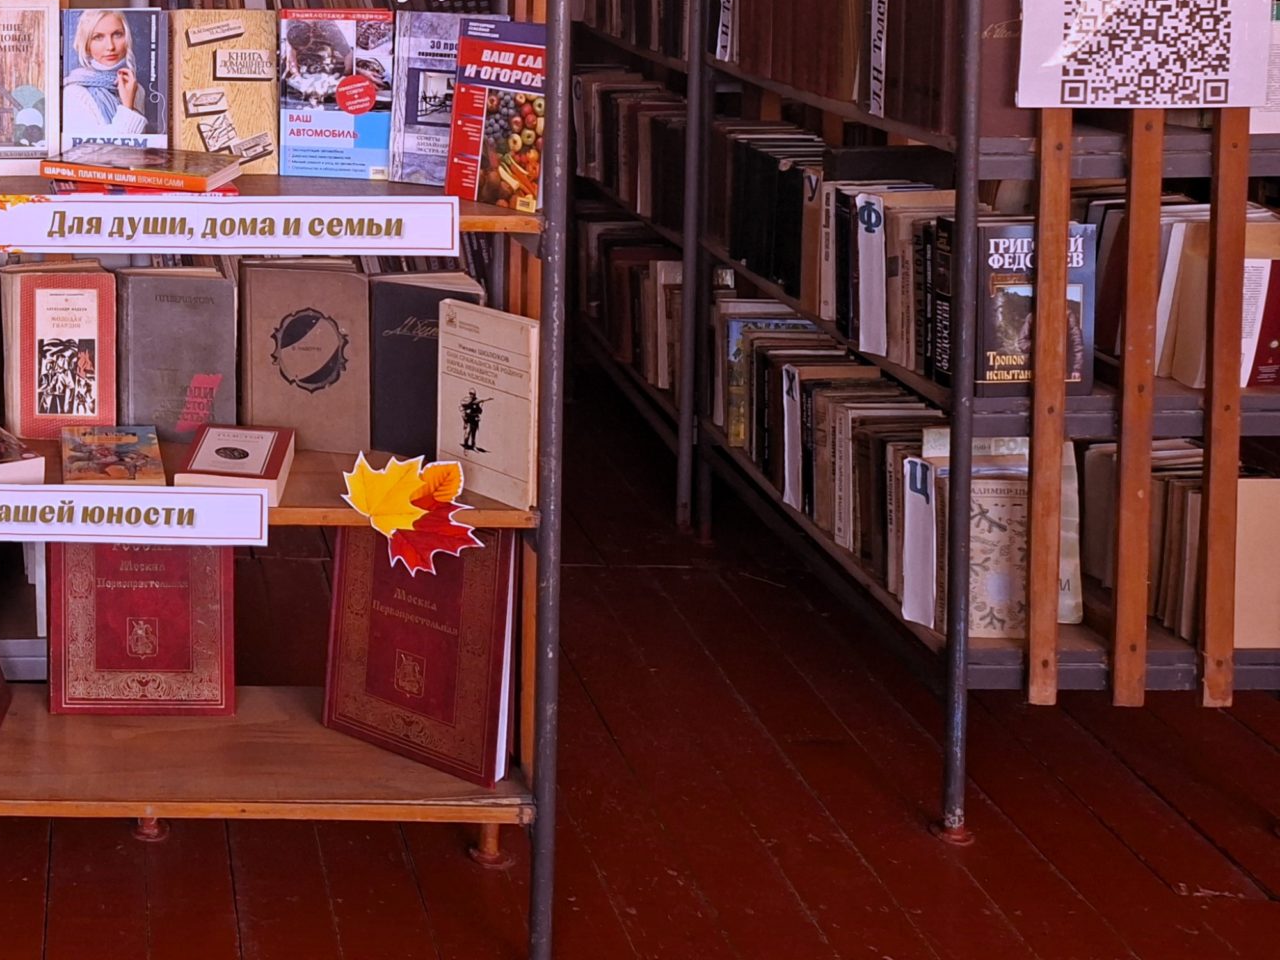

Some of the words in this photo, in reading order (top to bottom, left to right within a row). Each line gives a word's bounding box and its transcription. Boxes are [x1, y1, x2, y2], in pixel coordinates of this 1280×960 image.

[430, 40, 441, 50] 30
[227, 51, 264, 61] КНИГА
[481, 49, 514, 64] ВАШ
[517, 54, 543, 69] САД
[480, 68, 543, 88] ОГОРОД
[288, 114, 313, 124] ВАШ
[288, 128, 359, 139] АВТОМОБИЛЬ
[44, 166, 77, 179] ШАРФЫ,
[78, 169, 107, 180] ПЛАТКИ
[114, 172, 137, 183] ШАЛИ
[47, 210, 102, 238] Для
[107, 215, 195, 240] души,
[201, 216, 275, 239] дома
[283, 217, 302, 235] и
[307, 216, 404, 237] семьи
[858, 200, 882, 234] Ф
[907, 460, 930, 504] Ц
[81, 506, 196, 527] юности
